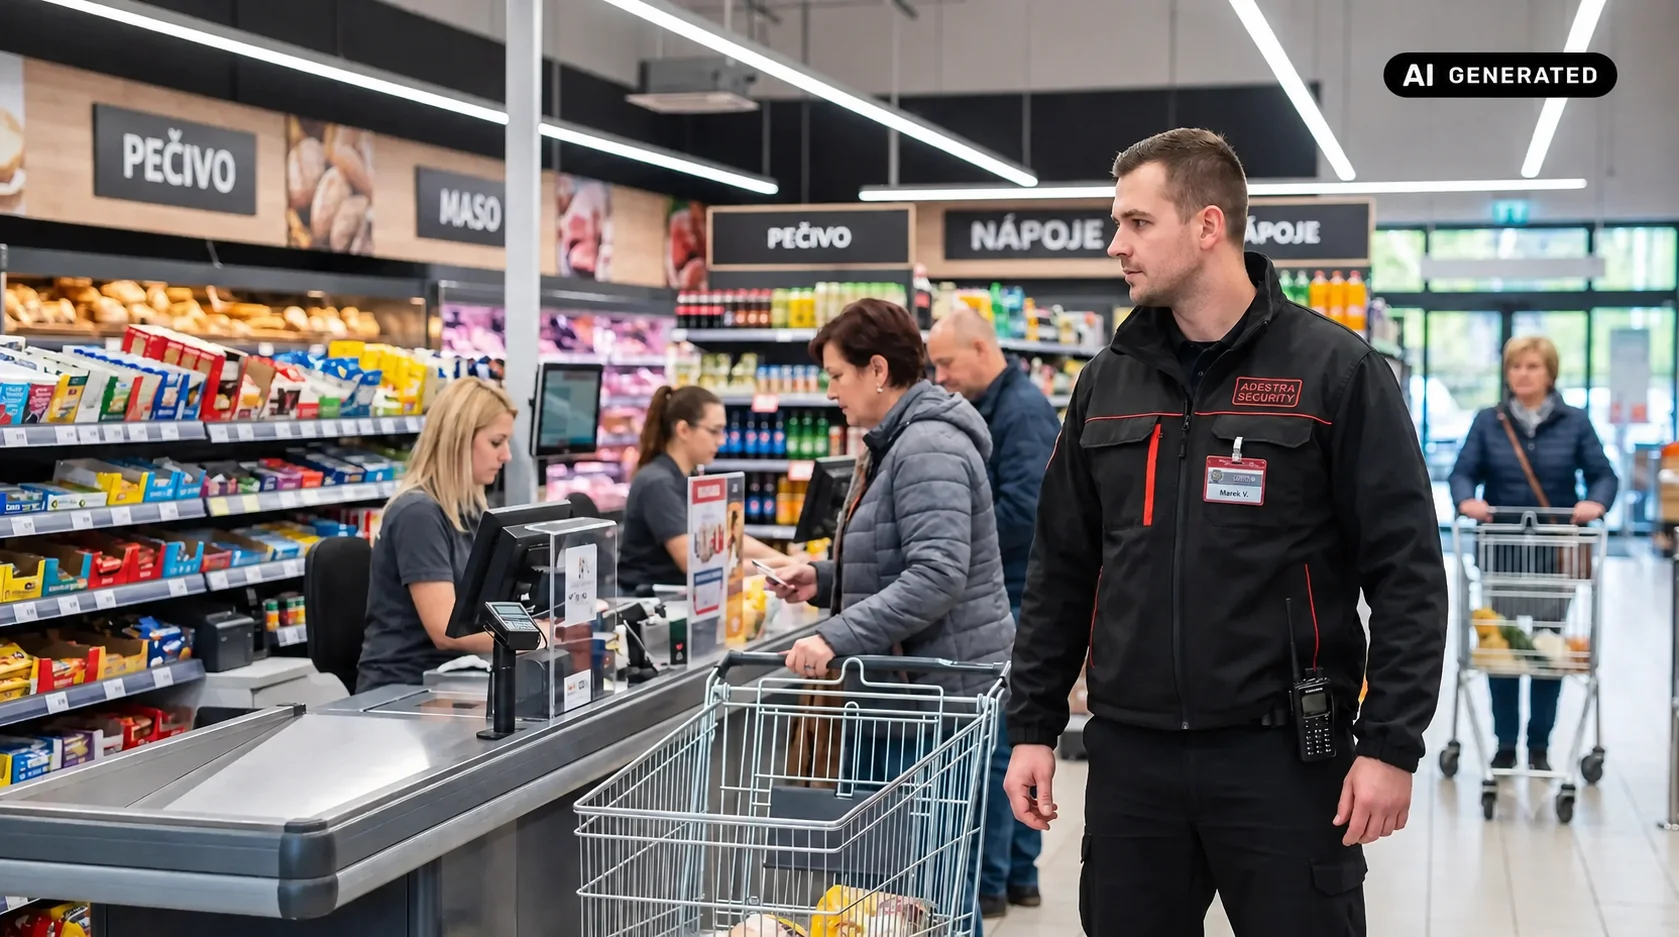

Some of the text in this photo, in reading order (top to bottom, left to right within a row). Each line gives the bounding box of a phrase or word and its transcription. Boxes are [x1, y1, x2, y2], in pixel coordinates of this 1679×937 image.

[123, 127, 236, 194] PEČIVO
[439, 187, 502, 233] MASO
[767, 221, 852, 249] PEČIVO
[970, 213, 1105, 251] NÁPOJE
[1244, 215, 1321, 245] ÁPOJE
[1240, 382, 1296, 393] ADESTRA
[1219, 489, 1241, 498] Marek
